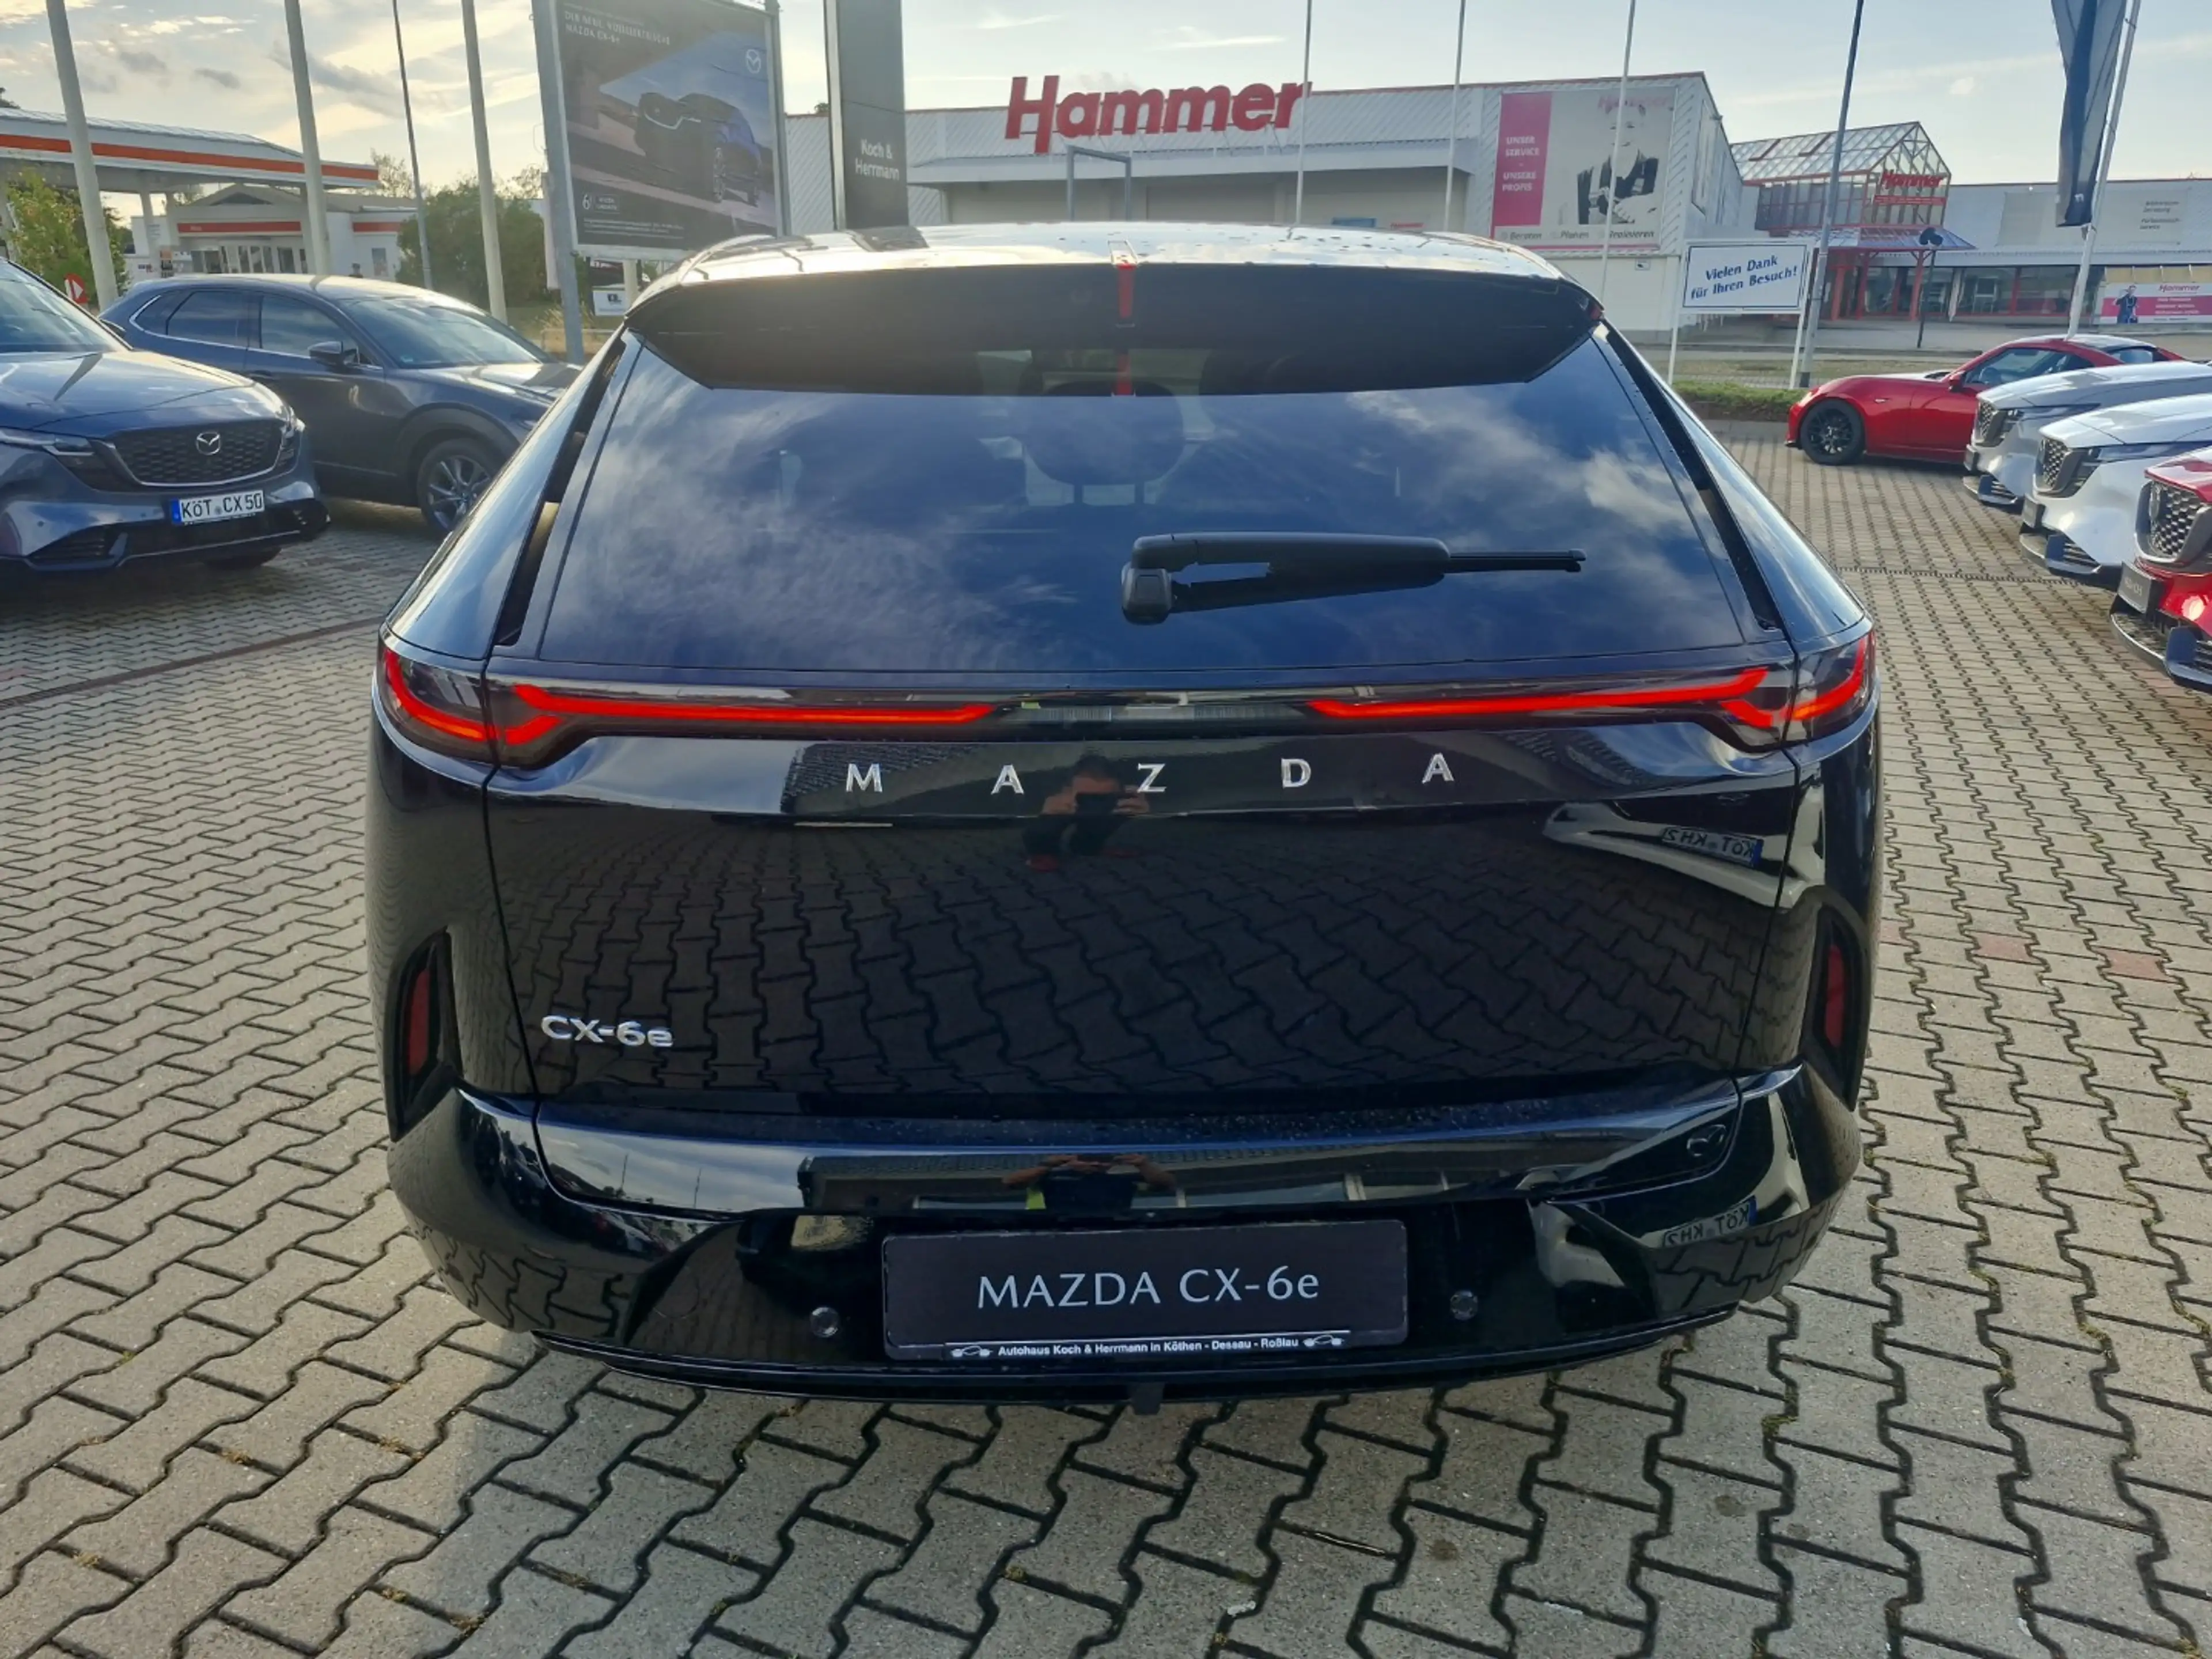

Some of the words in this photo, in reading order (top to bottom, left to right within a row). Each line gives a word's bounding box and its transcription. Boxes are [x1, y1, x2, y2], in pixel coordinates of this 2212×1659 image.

[1005, 75, 1312, 153] Hammer
[861, 138, 884, 158] Koch
[855, 157, 899, 181] Herrmann
[1691, 287, 1709, 300] für
[1713, 280, 1744, 294] Ihren
[1749, 265, 1797, 286] Besuch!
[1706, 265, 1741, 281] Vielen
[1747, 255, 1778, 272] Dank
[182, 499, 211, 517] KÖT
[845, 752, 1455, 794] MAZDA
[541, 1015, 674, 1047] CX-6e
[978, 1271, 1161, 1308] MAZDA
[1179, 1266, 1319, 1302] CX-6e
[998, 1346, 1050, 1356] Autohaus
[1053, 1345, 1081, 1354] Koch
[1084, 1344, 1092, 1354] &
[1096, 1343, 1147, 1354] Herrmann
[1150, 1342, 1161, 1352] in
[1164, 1340, 1202, 1351] Köthen
[1211, 1340, 1251, 1350] Dessau
[1261, 1338, 1299, 1349] Roßlau
